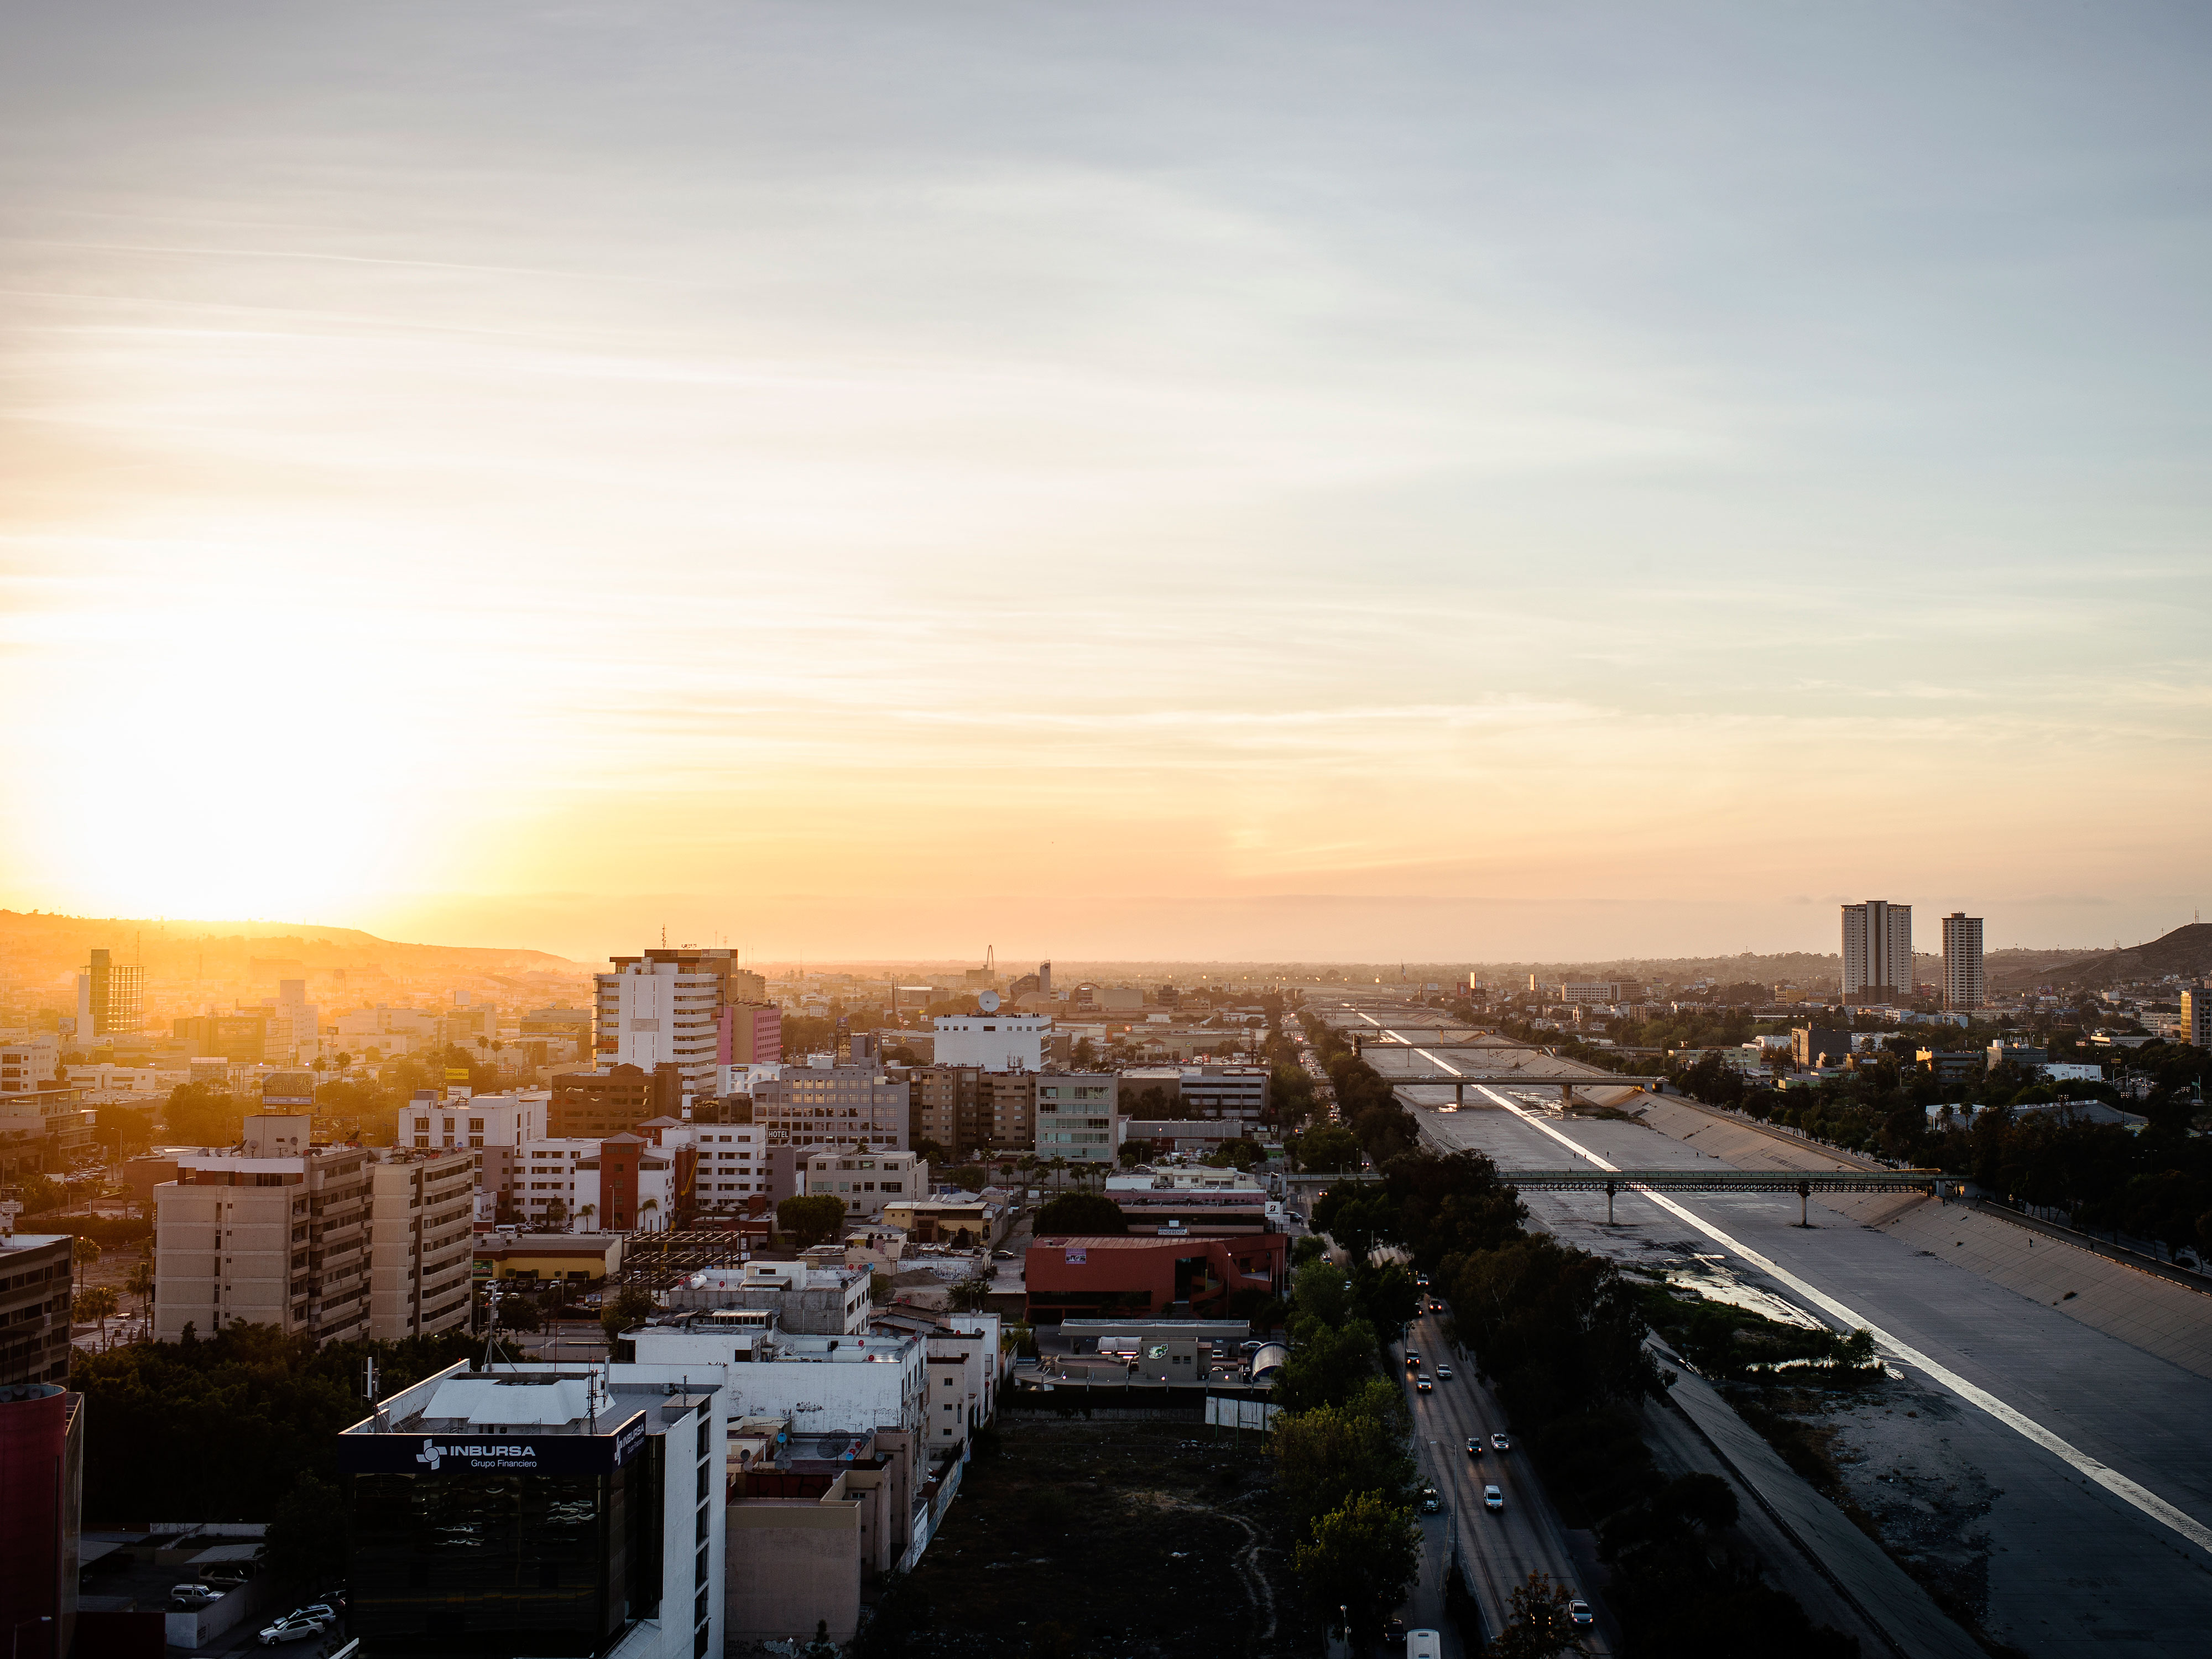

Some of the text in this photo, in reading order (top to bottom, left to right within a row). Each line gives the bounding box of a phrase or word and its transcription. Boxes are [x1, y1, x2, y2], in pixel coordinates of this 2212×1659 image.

[296, 1075, 310, 1087] 96
[623, 1423, 644, 1447] INBURSA
[450, 1446, 535, 1456] INBURSA
[471, 1459, 495, 1468] Grupo
